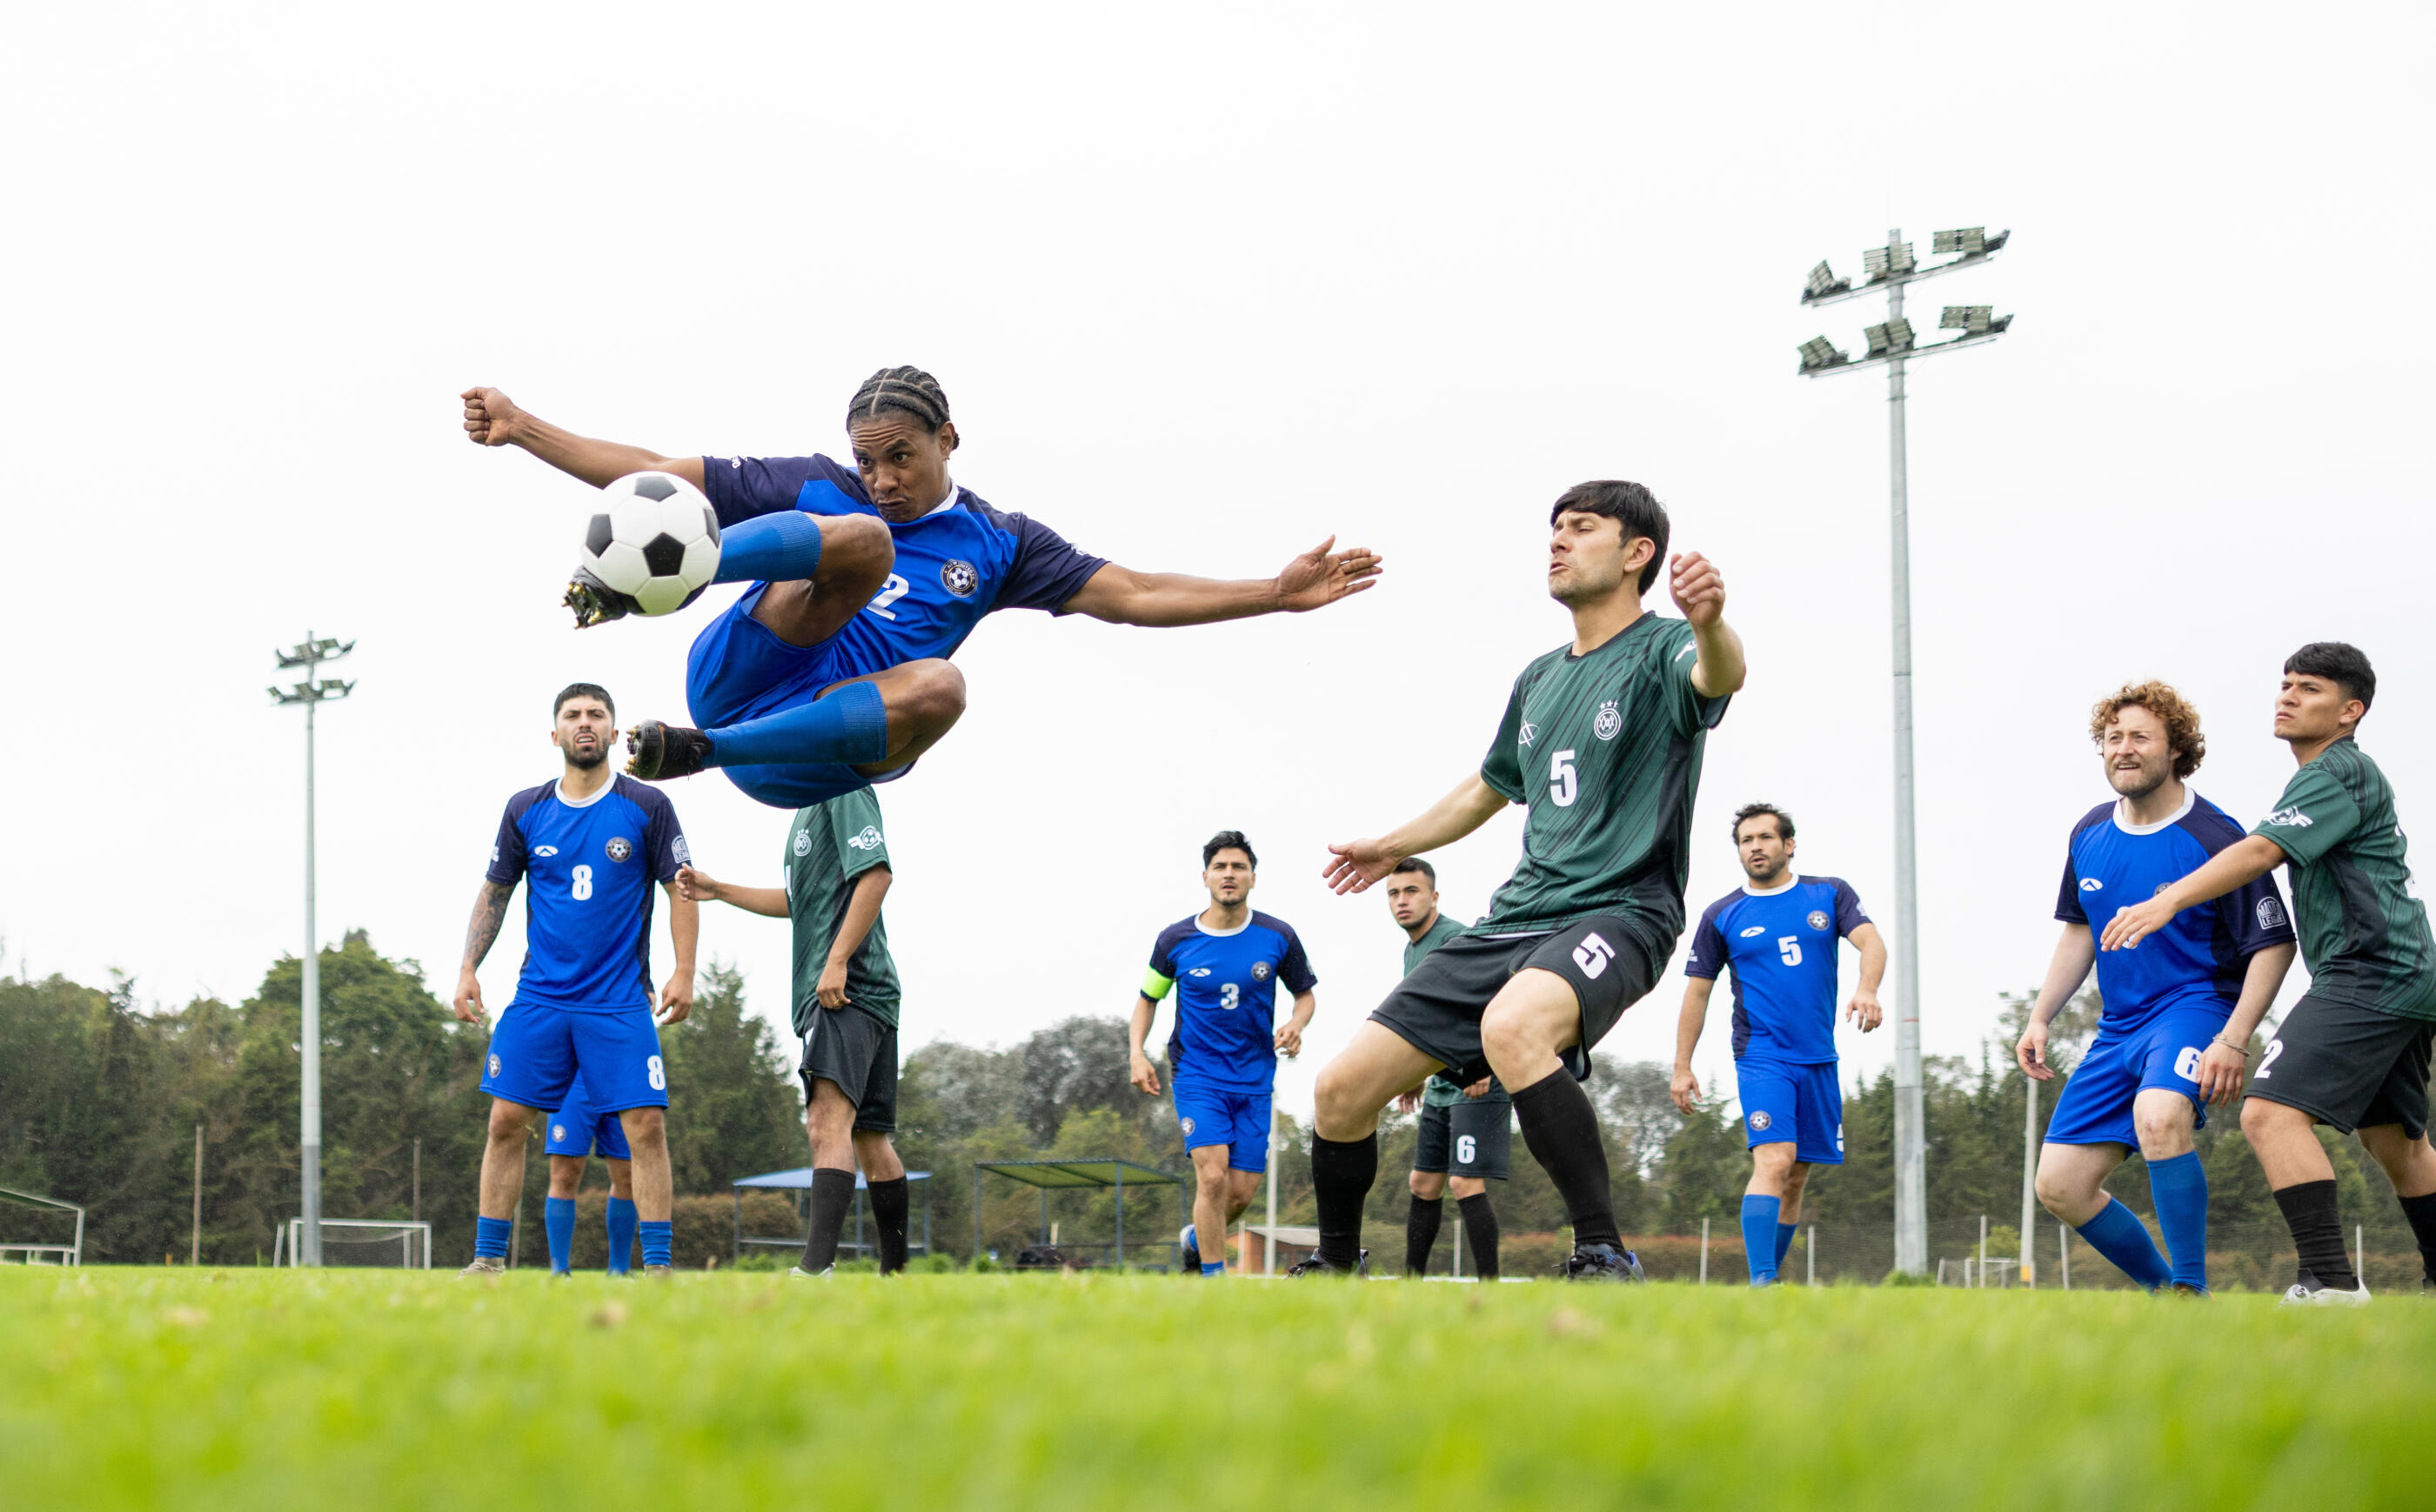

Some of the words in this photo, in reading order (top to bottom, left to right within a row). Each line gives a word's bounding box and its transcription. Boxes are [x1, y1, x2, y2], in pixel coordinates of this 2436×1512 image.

[866, 572, 909, 621] 2
[1549, 749, 1577, 807] 5
[572, 865, 592, 901] 8
[1572, 932, 1616, 980] 5
[1777, 935, 1803, 967] 5
[1221, 983, 1240, 1010] 3
[647, 1055, 666, 1090] 8
[2173, 1047, 2203, 1084] 6
[2253, 1040, 2284, 1079] 2
[1456, 1134, 1476, 1164] 6
